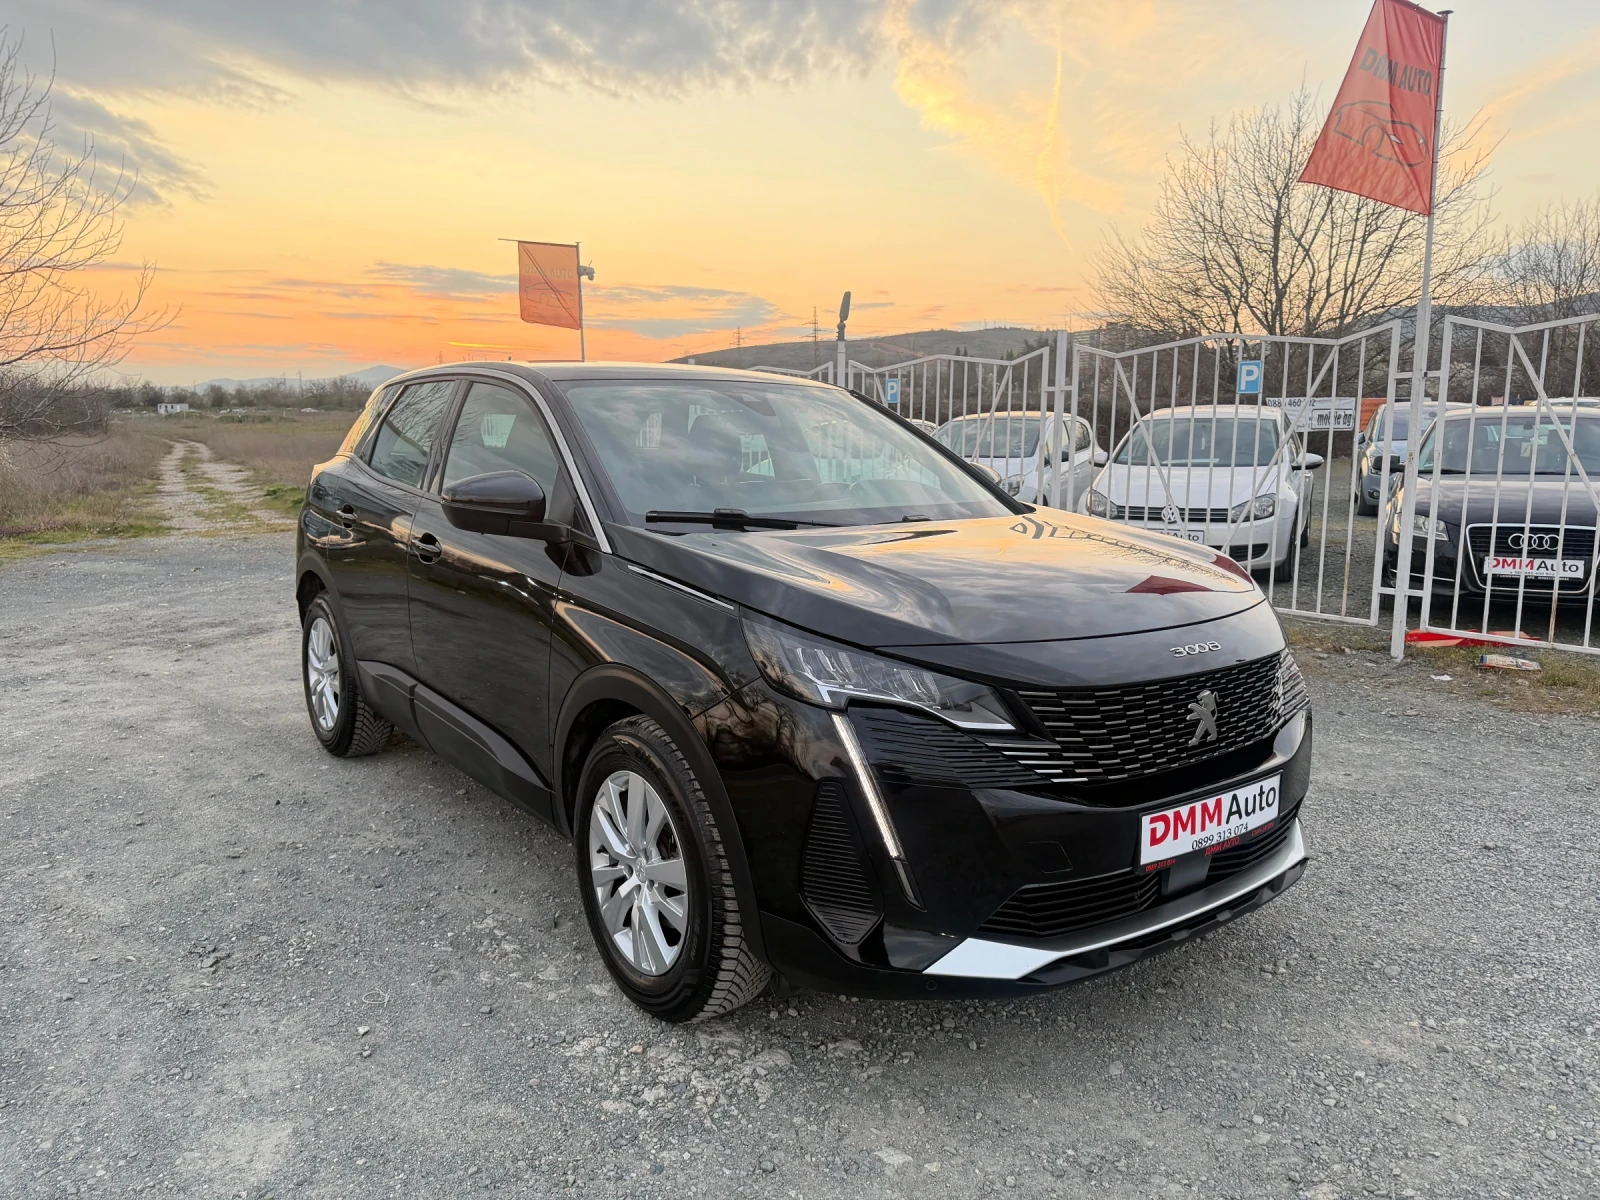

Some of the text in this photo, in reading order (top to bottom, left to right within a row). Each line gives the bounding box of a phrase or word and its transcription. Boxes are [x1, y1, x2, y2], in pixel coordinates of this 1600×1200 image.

[1397, 64, 1433, 96] AUTO
[550, 267, 574, 279] AUTO
[1240, 365, 1259, 391] P
[887, 382, 897, 401] P
[1169, 640, 1222, 658] 3008
[1191, 834, 1214, 850] 0899
[1216, 828, 1232, 842] 313
[1233, 822, 1249, 835] 074
